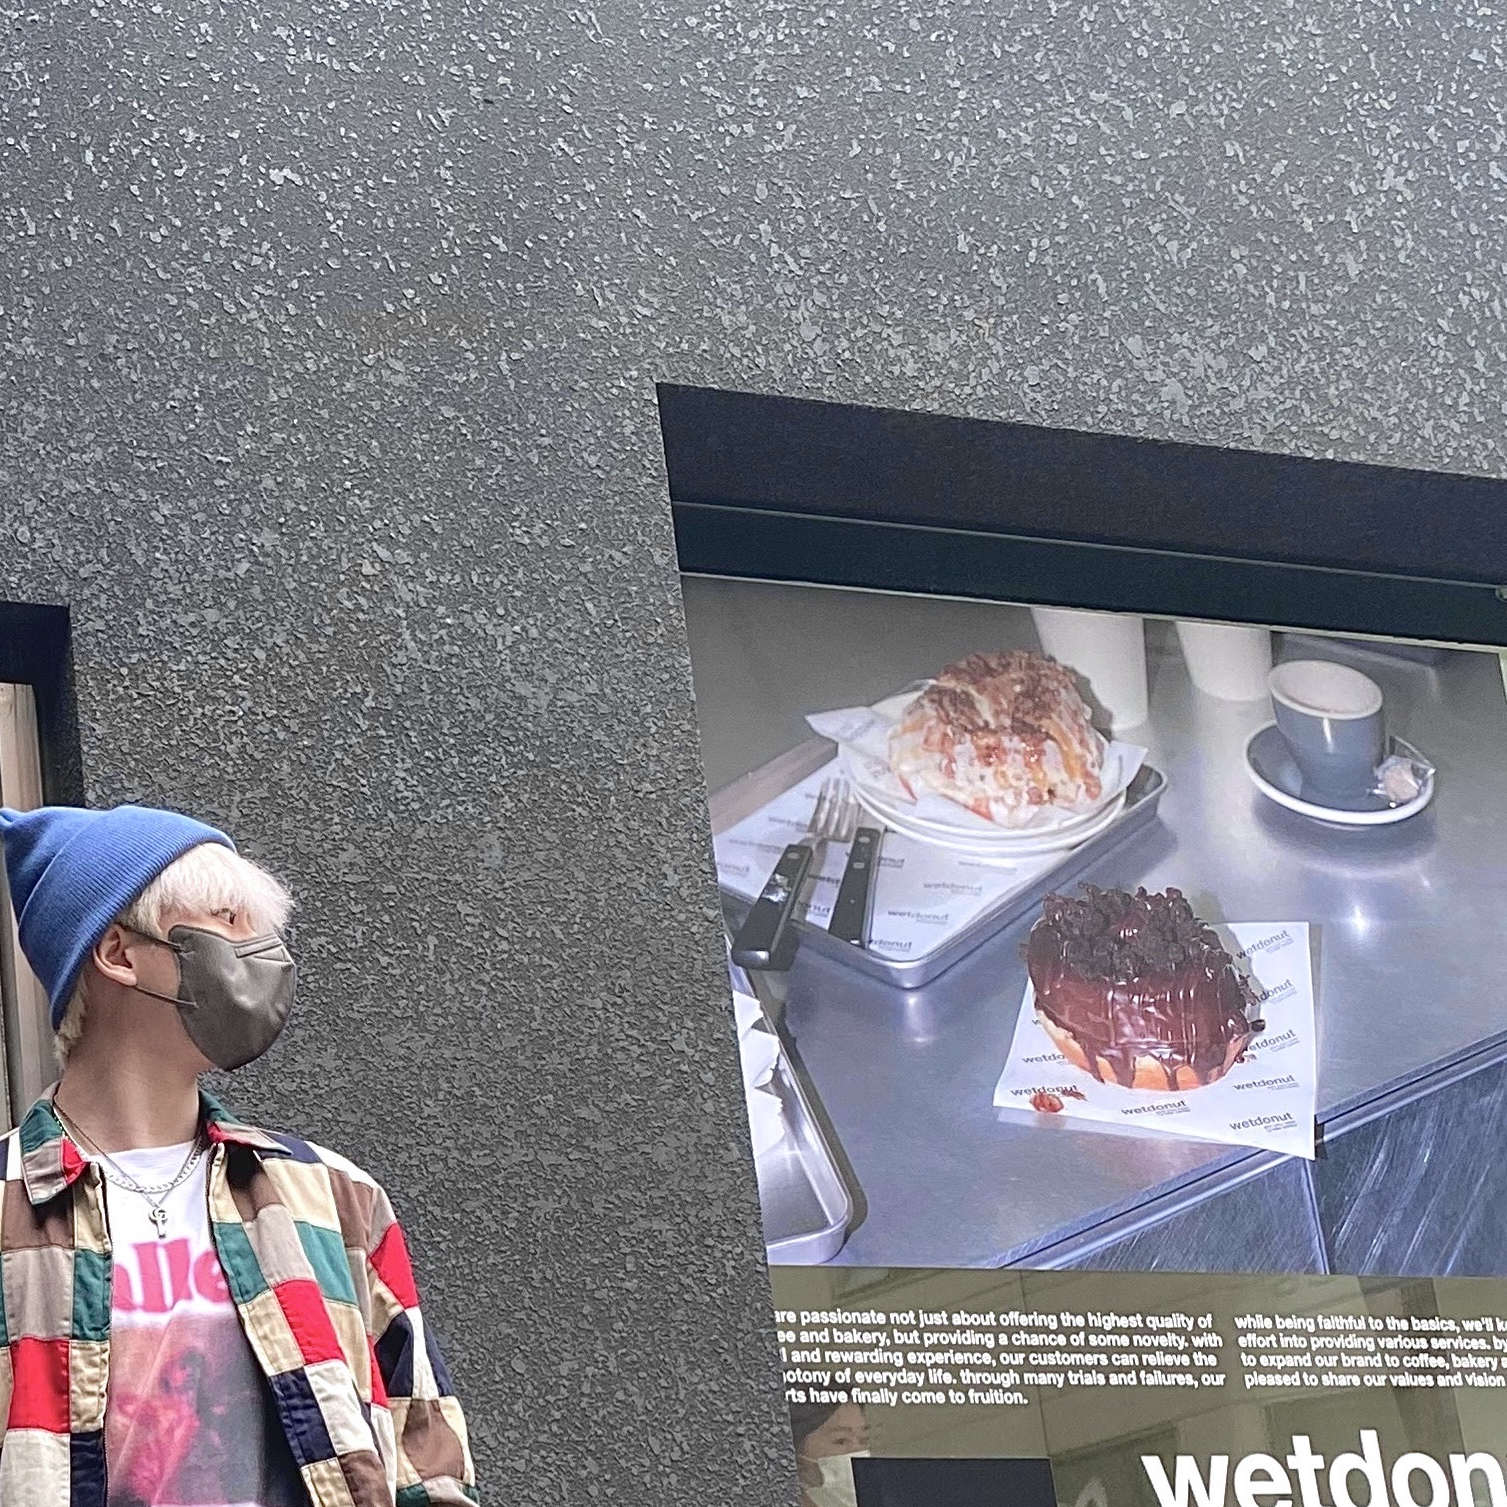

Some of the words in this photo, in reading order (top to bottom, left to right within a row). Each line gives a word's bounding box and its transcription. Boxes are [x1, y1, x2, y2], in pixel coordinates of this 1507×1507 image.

[1248, 1029, 1296, 1051] etdonut
[1233, 1074, 1296, 1090] wetdonut
[1121, 1099, 1187, 1116] wetdonut
[1229, 1112, 1294, 1130] wetdonut
[801, 1309, 886, 1326] passionate
[890, 1310, 915, 1325] not
[919, 1310, 948, 1327] just
[951, 1312, 996, 1326] about
[1000, 1311, 1058, 1330] offering
[1061, 1312, 1085, 1327] the
[1087, 1312, 1143, 1330] highest
[1145, 1313, 1193, 1331] quality
[1198, 1313, 1212, 1328] of
[1235, 1314, 1272, 1330] while
[1275, 1315, 1315, 1332] being
[1317, 1315, 1366, 1331] faithful
[1368, 1316, 1383, 1330] to
[1386, 1316, 1409, 1331] the
[1411, 1316, 1460, 1333] basics,
[1462, 1316, 1494, 1332] we'll
[800, 1328, 829, 1343] and
[833, 1328, 891, 1346] bakery,
[893, 1329, 920, 1344] but
[924, 1330, 994, 1348] providing
[999, 1333, 1008, 1345] a
[1012, 1331, 1066, 1346] chance
[1070, 1332, 1085, 1346] of
[1089, 1335, 1129, 1347] some
[1133, 1333, 1188, 1350] novelty.
[1192, 1333, 1223, 1348] with
[1238, 1334, 1276, 1348] effort
[1280, 1334, 1307, 1348] into
[1311, 1334, 1375, 1351] providing
[1378, 1336, 1428, 1349] various
[1430, 1336, 1491, 1350] services.
[791, 1348, 821, 1363] and
[825, 1348, 903, 1367] rewarding
[907, 1349, 996, 1367] experience,
[1000, 1353, 1025, 1366] our
[1029, 1351, 1108, 1366] customers
[1112, 1353, 1139, 1366] can
[1142, 1352, 1190, 1366] relieve
[1193, 1352, 1217, 1366] the
[1241, 1352, 1256, 1367] to
[1260, 1353, 1312, 1369] expand
[1315, 1355, 1339, 1367] our
[1342, 1353, 1383, 1368] brand
[1385, 1354, 1400, 1368] to
[1403, 1354, 1450, 1370] coffee,
[1452, 1354, 1498, 1370] bakery
[783, 1368, 830, 1385] otony
[835, 1368, 851, 1383] of
[855, 1368, 925, 1386] everyday
[928, 1369, 957, 1384] life.
[960, 1369, 1020, 1388] through
[1024, 1371, 1064, 1388] many
[1068, 1370, 1106, 1385] trials
[1109, 1371, 1137, 1385] and
[1140, 1371, 1199, 1388] failures,
[1202, 1373, 1226, 1385] our
[1245, 1371, 1300, 1389] pleased
[1303, 1372, 1318, 1386] to
[1322, 1372, 1360, 1386] share
[1363, 1375, 1387, 1387] our
[1390, 1373, 1434, 1387] values
[1437, 1373, 1463, 1387] and
[1465, 1373, 1505, 1387] vision
[810, 1388, 848, 1403] have
[851, 1388, 898, 1406] finally
[901, 1390, 945, 1404] come
[949, 1389, 965, 1404] to
[968, 1389, 1029, 1404] fruition.
